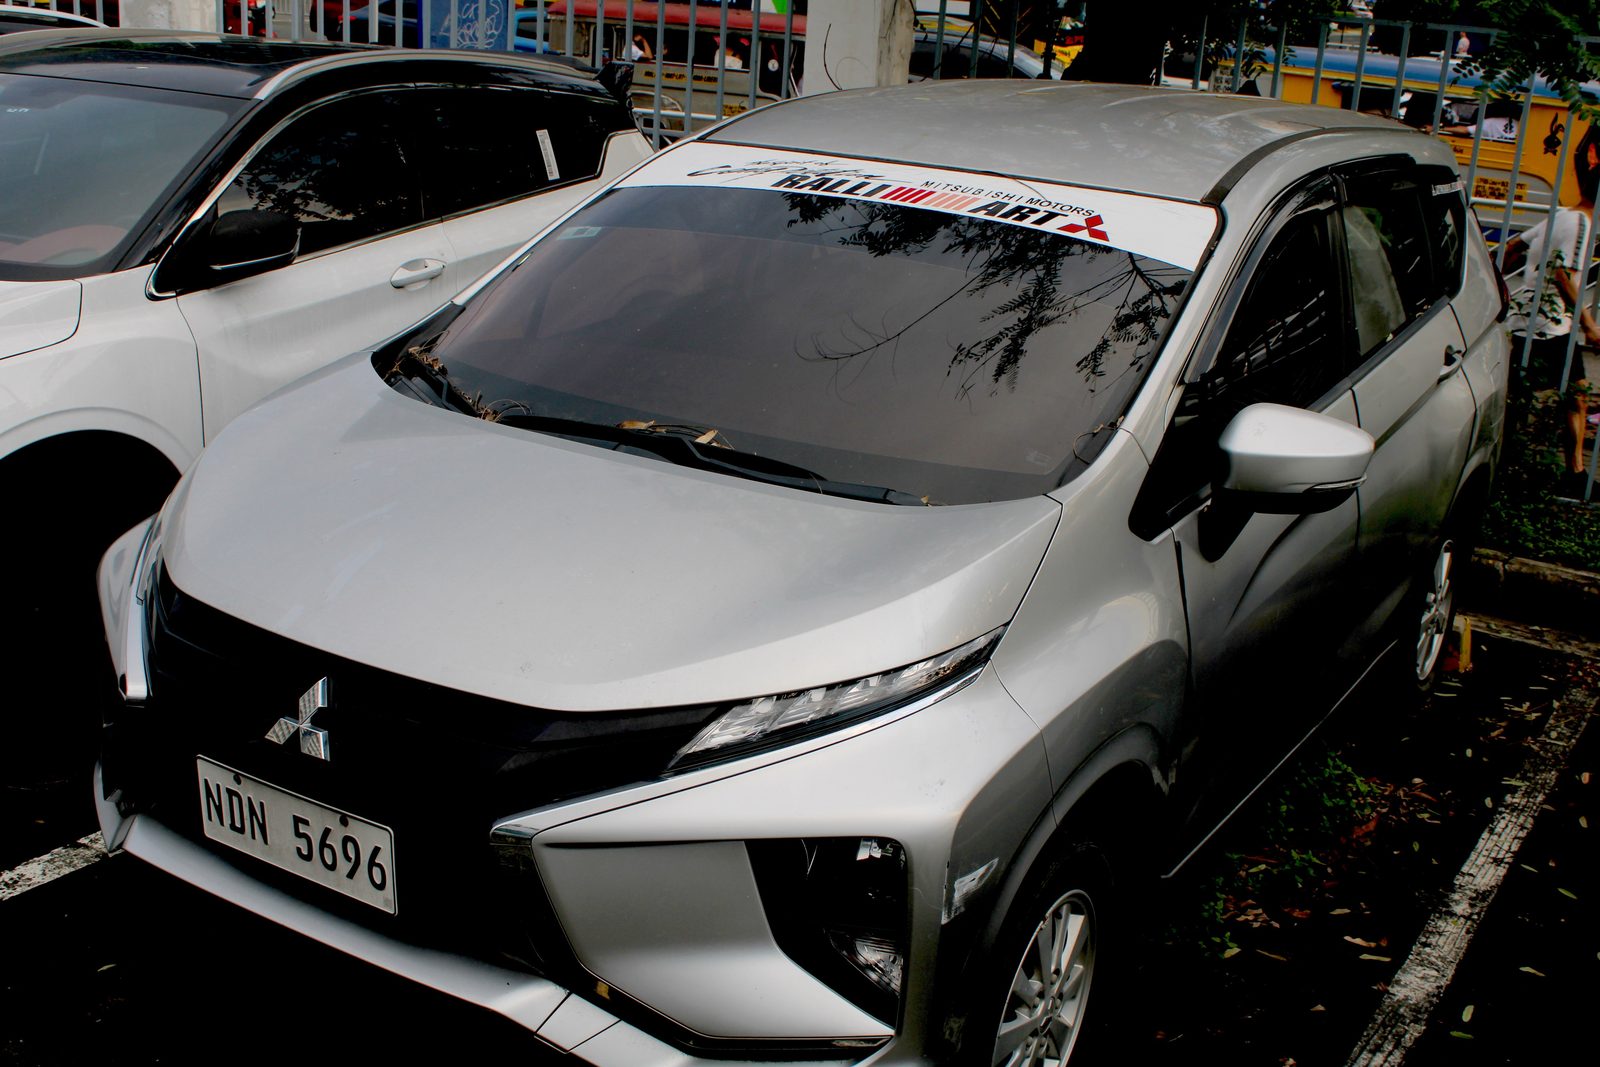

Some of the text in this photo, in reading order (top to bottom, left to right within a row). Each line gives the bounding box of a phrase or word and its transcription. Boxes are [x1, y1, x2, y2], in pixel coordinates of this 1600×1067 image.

[920, 180, 1095, 217] MITSUBISHI MOTORS
[204, 777, 387, 892] NDN 5696
